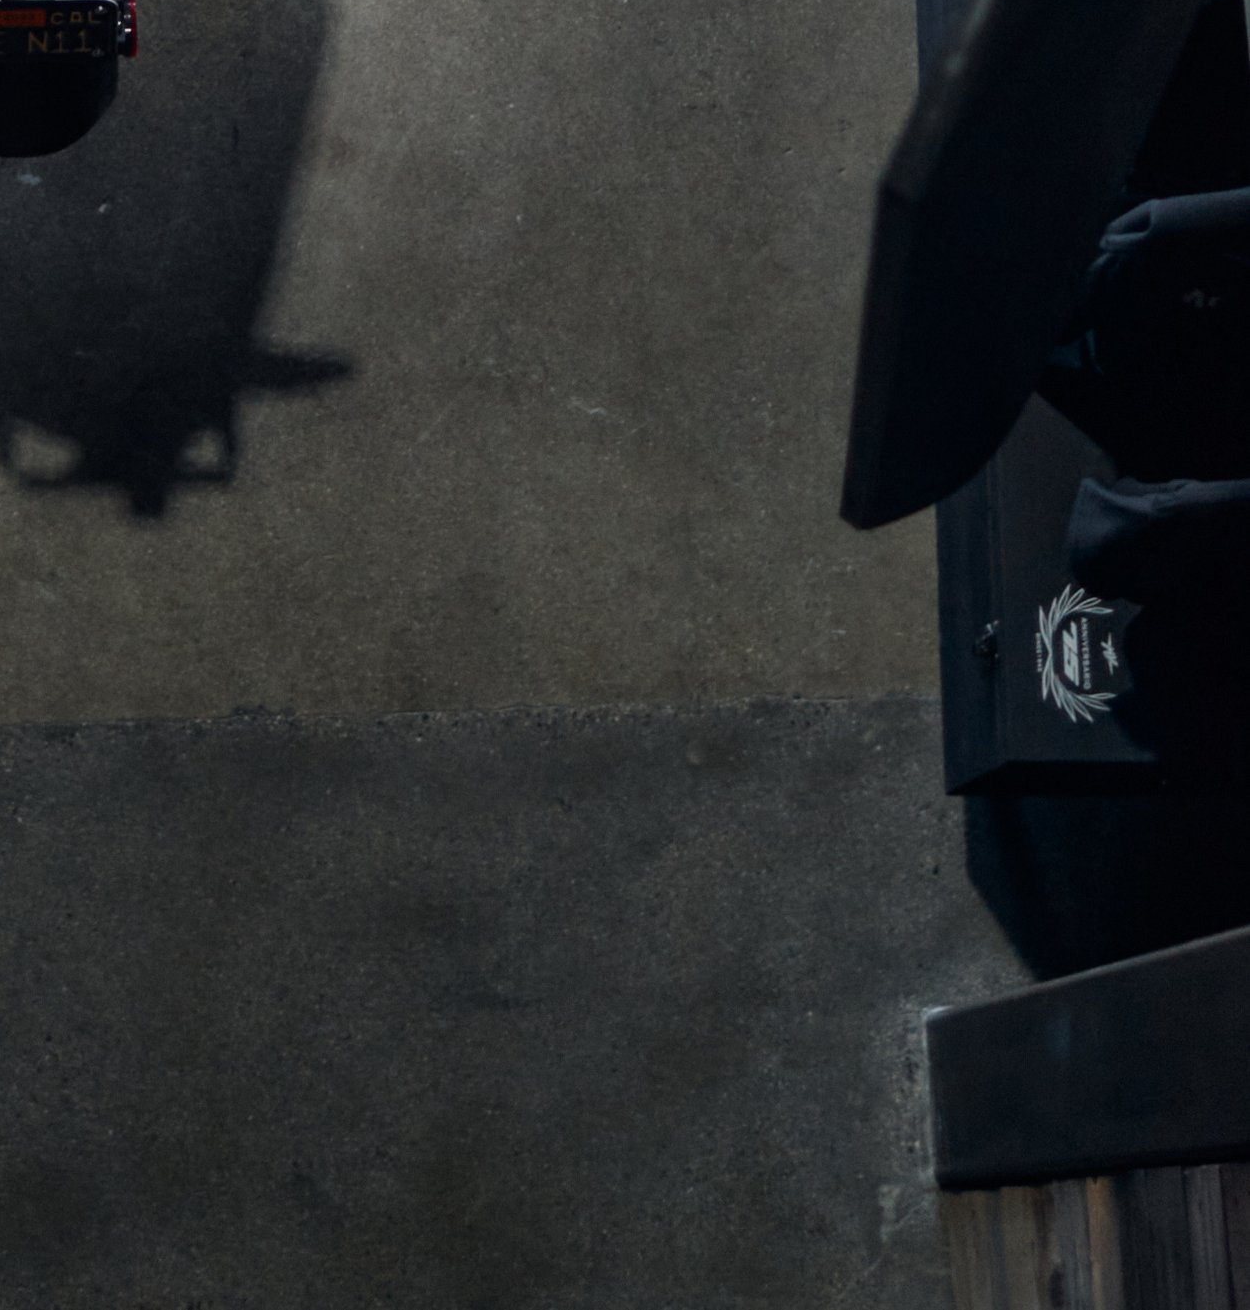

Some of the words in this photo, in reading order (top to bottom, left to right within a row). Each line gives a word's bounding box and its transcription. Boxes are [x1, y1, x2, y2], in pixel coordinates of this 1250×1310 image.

[49, 11, 103, 26] CAL
[27, 30, 92, 54] N11
[1061, 620, 1080, 687] 75
[1080, 617, 1092, 691] ANNIVERSARIO
